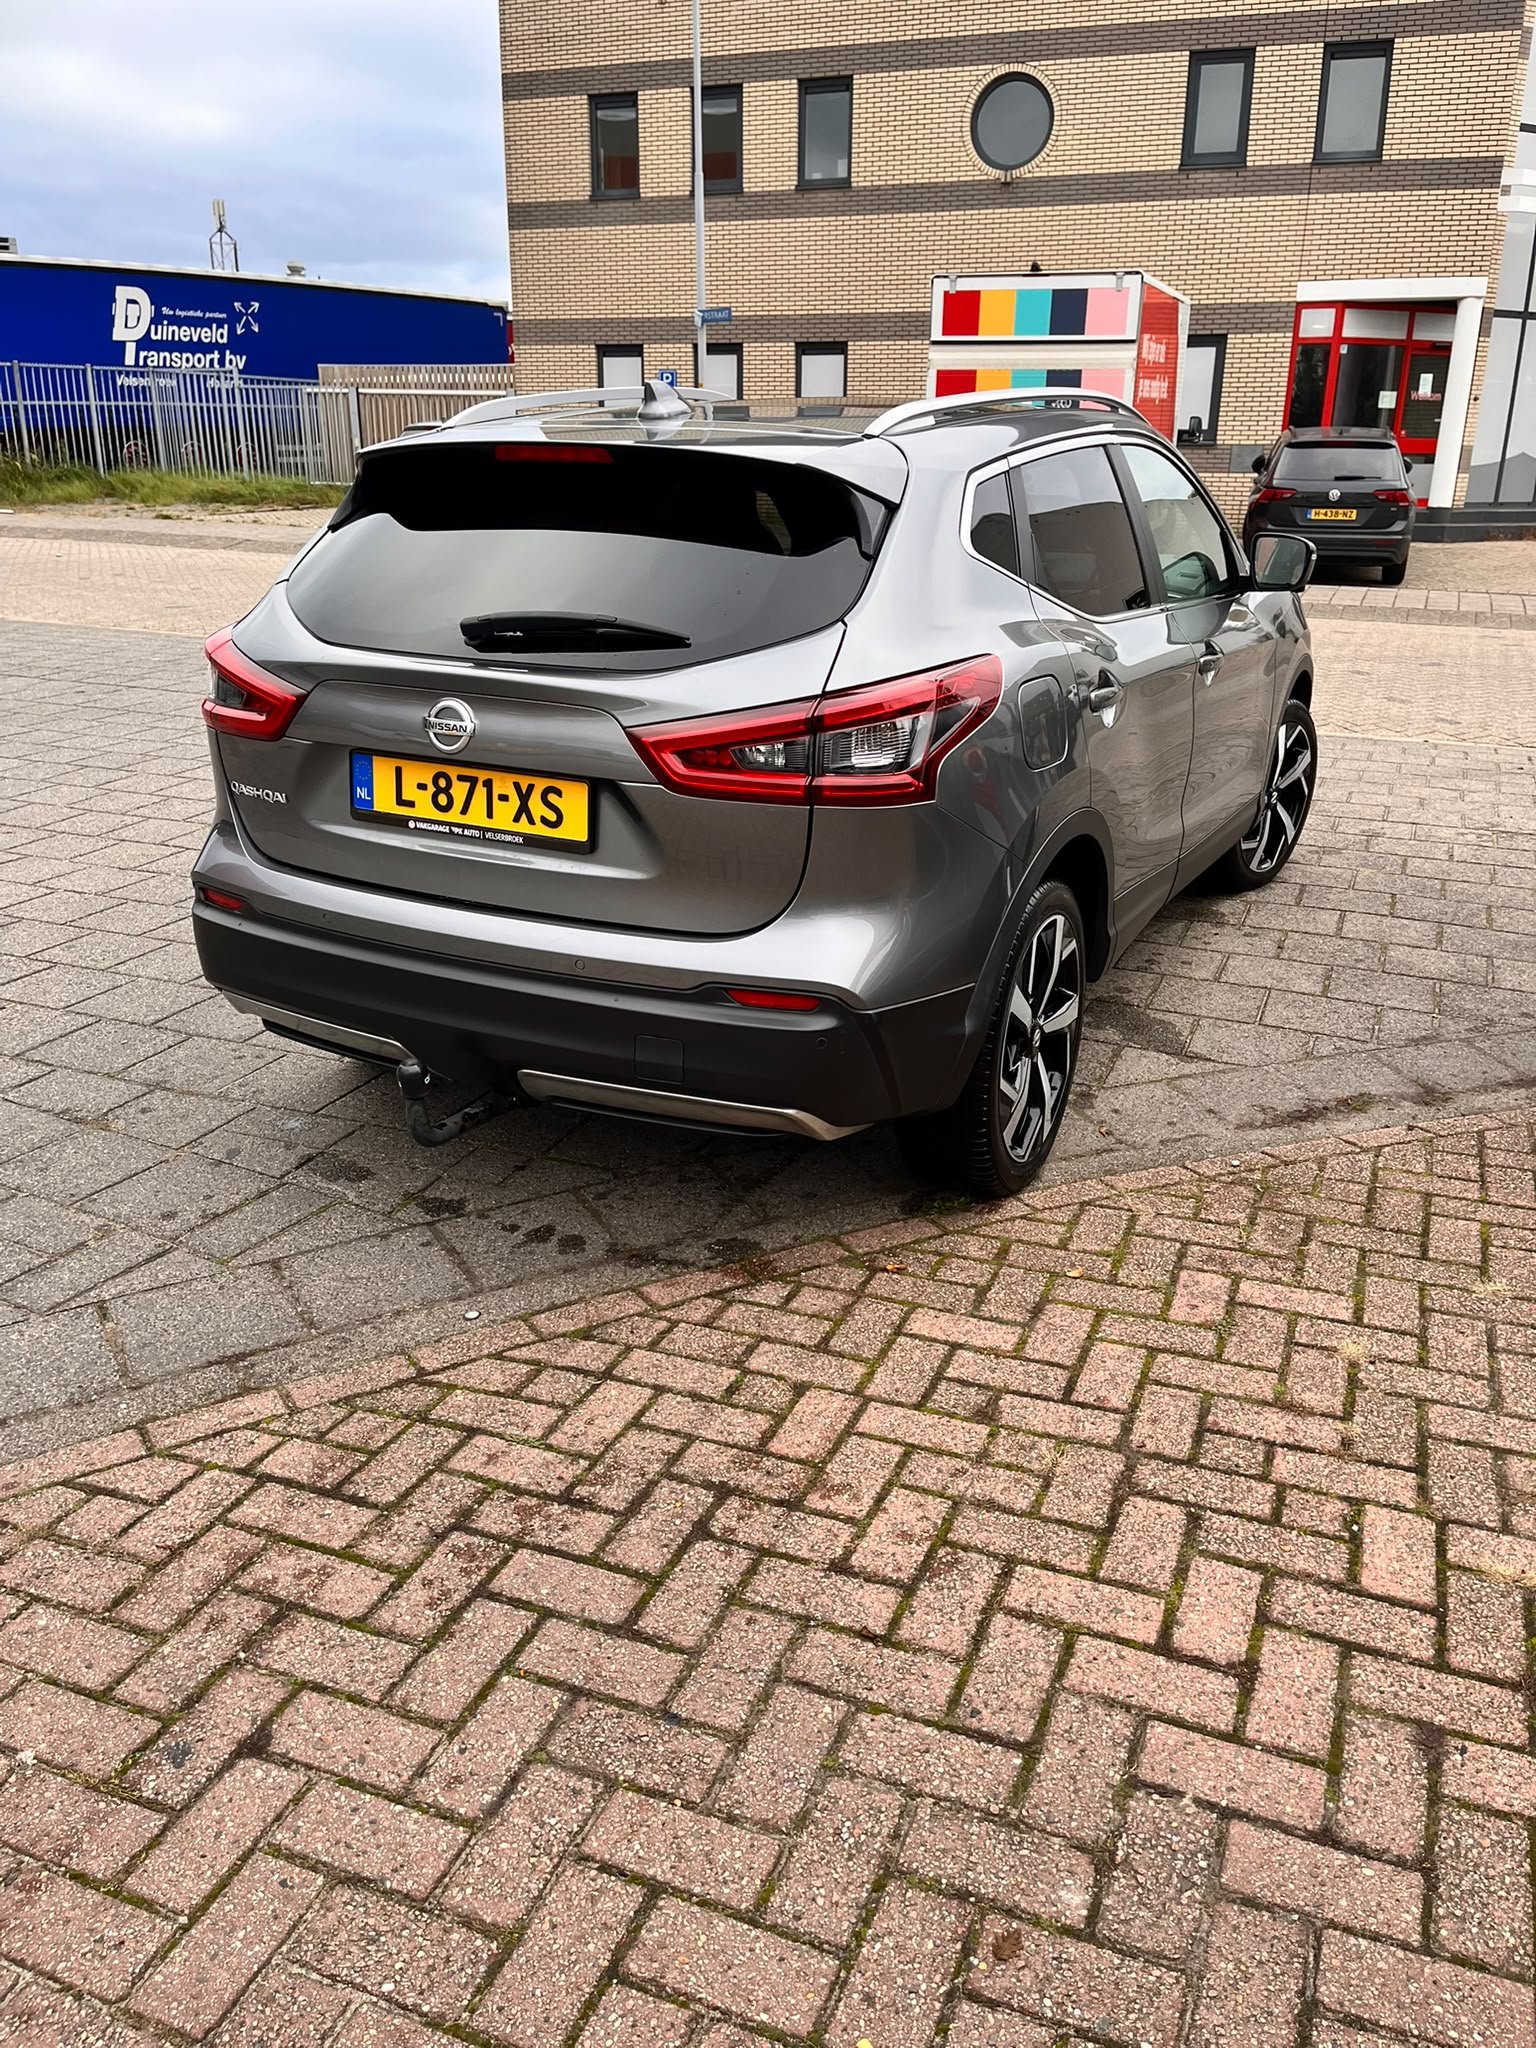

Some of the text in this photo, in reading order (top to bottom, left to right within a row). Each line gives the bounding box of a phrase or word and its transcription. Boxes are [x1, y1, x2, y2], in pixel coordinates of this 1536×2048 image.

[112, 286, 228, 344] Duineveld
[225, 350, 246, 370] bv
[1314, 510, 1354, 519] H-438-NZ
[428, 720, 468, 733] NISSAN
[230, 780, 287, 804] QASHQAI
[356, 787, 371, 800] NL
[395, 766, 564, 829] L-871-XS
[416, 821, 450, 833] VAKGARAGE
[464, 828, 480, 838] AUTO
[485, 831, 524, 844] VELSERBROEK
